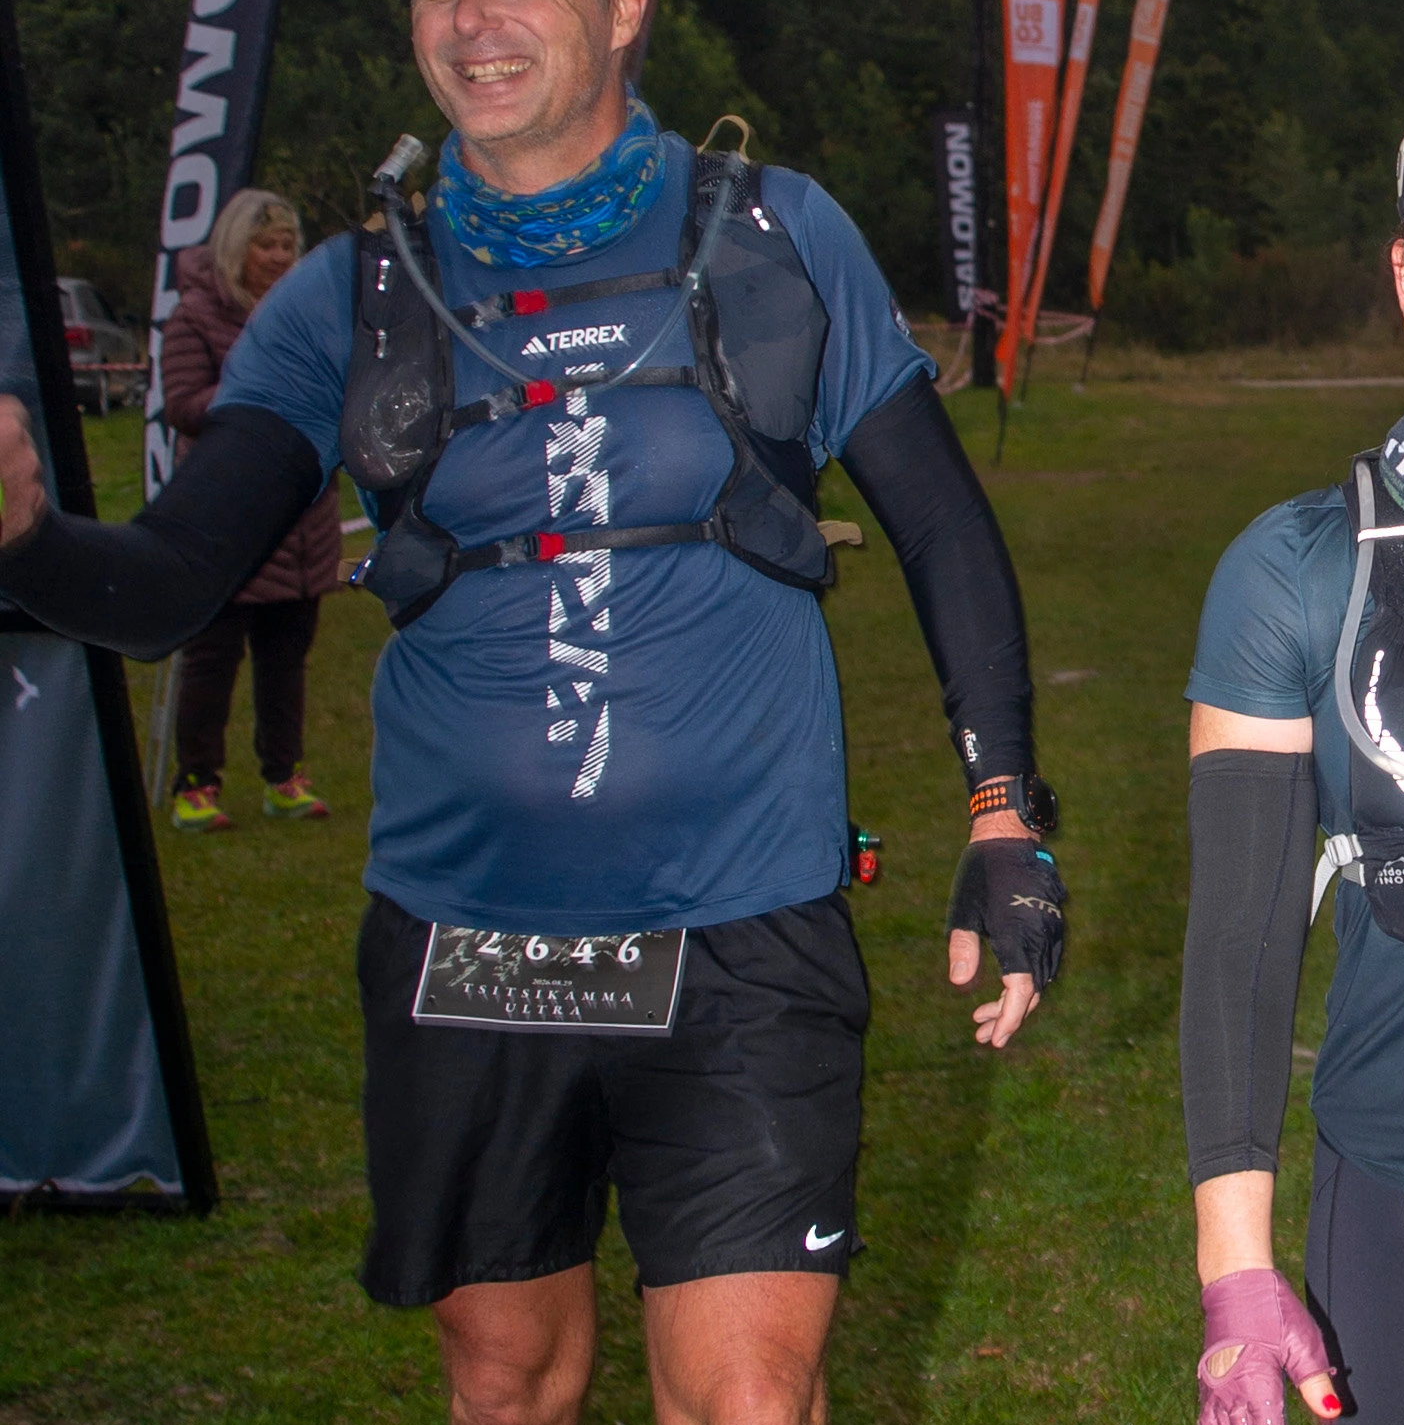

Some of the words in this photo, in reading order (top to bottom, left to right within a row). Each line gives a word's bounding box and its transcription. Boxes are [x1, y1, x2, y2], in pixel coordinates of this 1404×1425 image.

[944, 122, 978, 312] SALOMON
[546, 323, 626, 351] TERREX
[463, 982, 632, 1003] TSITSIKAMMA
[505, 1002, 581, 1016] ULTRA
